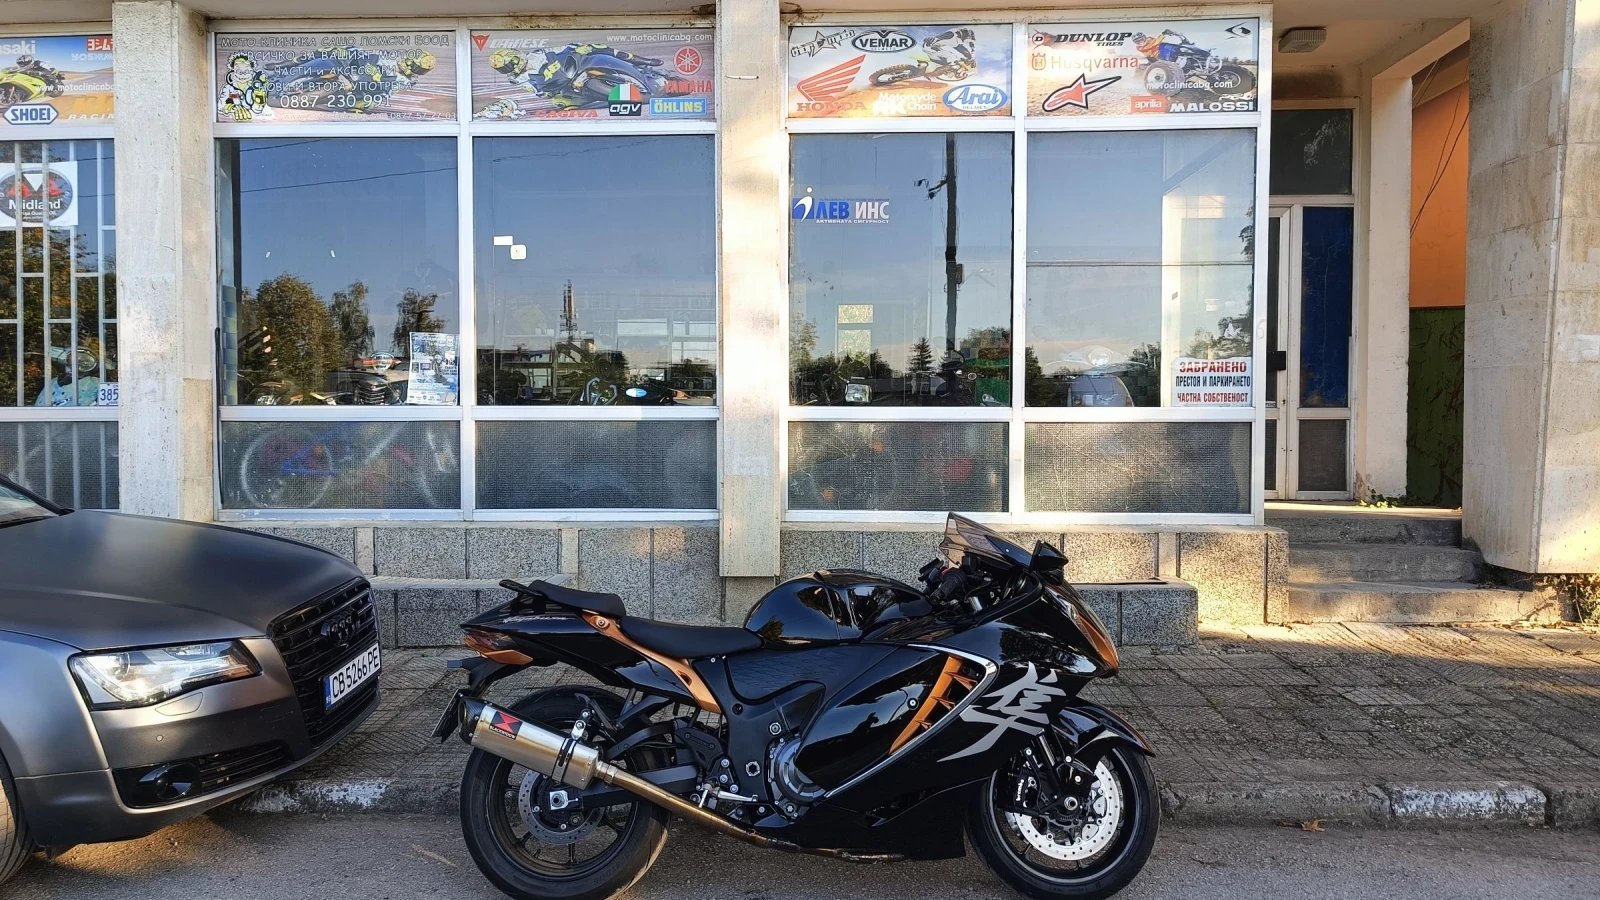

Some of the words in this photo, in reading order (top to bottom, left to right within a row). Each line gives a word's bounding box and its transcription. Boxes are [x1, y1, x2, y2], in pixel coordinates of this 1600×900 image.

[221, 37, 256, 47] МОТО
[261, 36, 316, 47] КЛИНИКА
[320, 36, 356, 46] САШО
[360, 35, 411, 47] ЛОМСКИ
[606, 33, 712, 43] www.motoclinicabg.com
[860, 38, 909, 48] VEMAR
[1054, 32, 1132, 43] DUNLOP
[0, 40, 36, 55] saki
[247, 51, 295, 60] ВСИЧКО
[300, 51, 315, 60] ЗА
[321, 50, 373, 60] ВАШИЯТ
[1051, 56, 1139, 72] Husqvarna
[274, 66, 312, 76] ЧАСТИ
[308, 81, 346, 91] ВТОРА
[351, 81, 413, 91] УПОТРЕБА
[664, 80, 712, 93] YAMAHA
[1146, 79, 1233, 90] motoclinicabg.com
[280, 95, 319, 108] 0887
[327, 94, 356, 107] 230
[363, 94, 391, 108] 991
[878, 92, 936, 102] Motorcycle
[948, 86, 1000, 105] Arai
[609, 103, 641, 115] agv
[654, 99, 703, 113] ÖHLINS
[796, 102, 867, 112] HONDA
[908, 102, 936, 111] Chain
[1134, 98, 1162, 109] aprilia
[1169, 101, 1254, 112] MALOSSI
[10, 107, 51, 122] SHOEI
[535, 109, 599, 118] CAGIVA
[815, 201, 850, 219] ЛЕВ
[855, 201, 890, 219] ИНС
[1179, 361, 1247, 373] ЗАБРАНЕНО
[1175, 375, 1201, 387] ПРЕСТОЯ
[1202, 375, 1207, 387] И
[1208, 375, 1251, 387] ПАРКИРАНЕТО
[1177, 392, 1201, 403] ЧАСТНА
[1203, 392, 1249, 403] СОБСТВЕНОСТ
